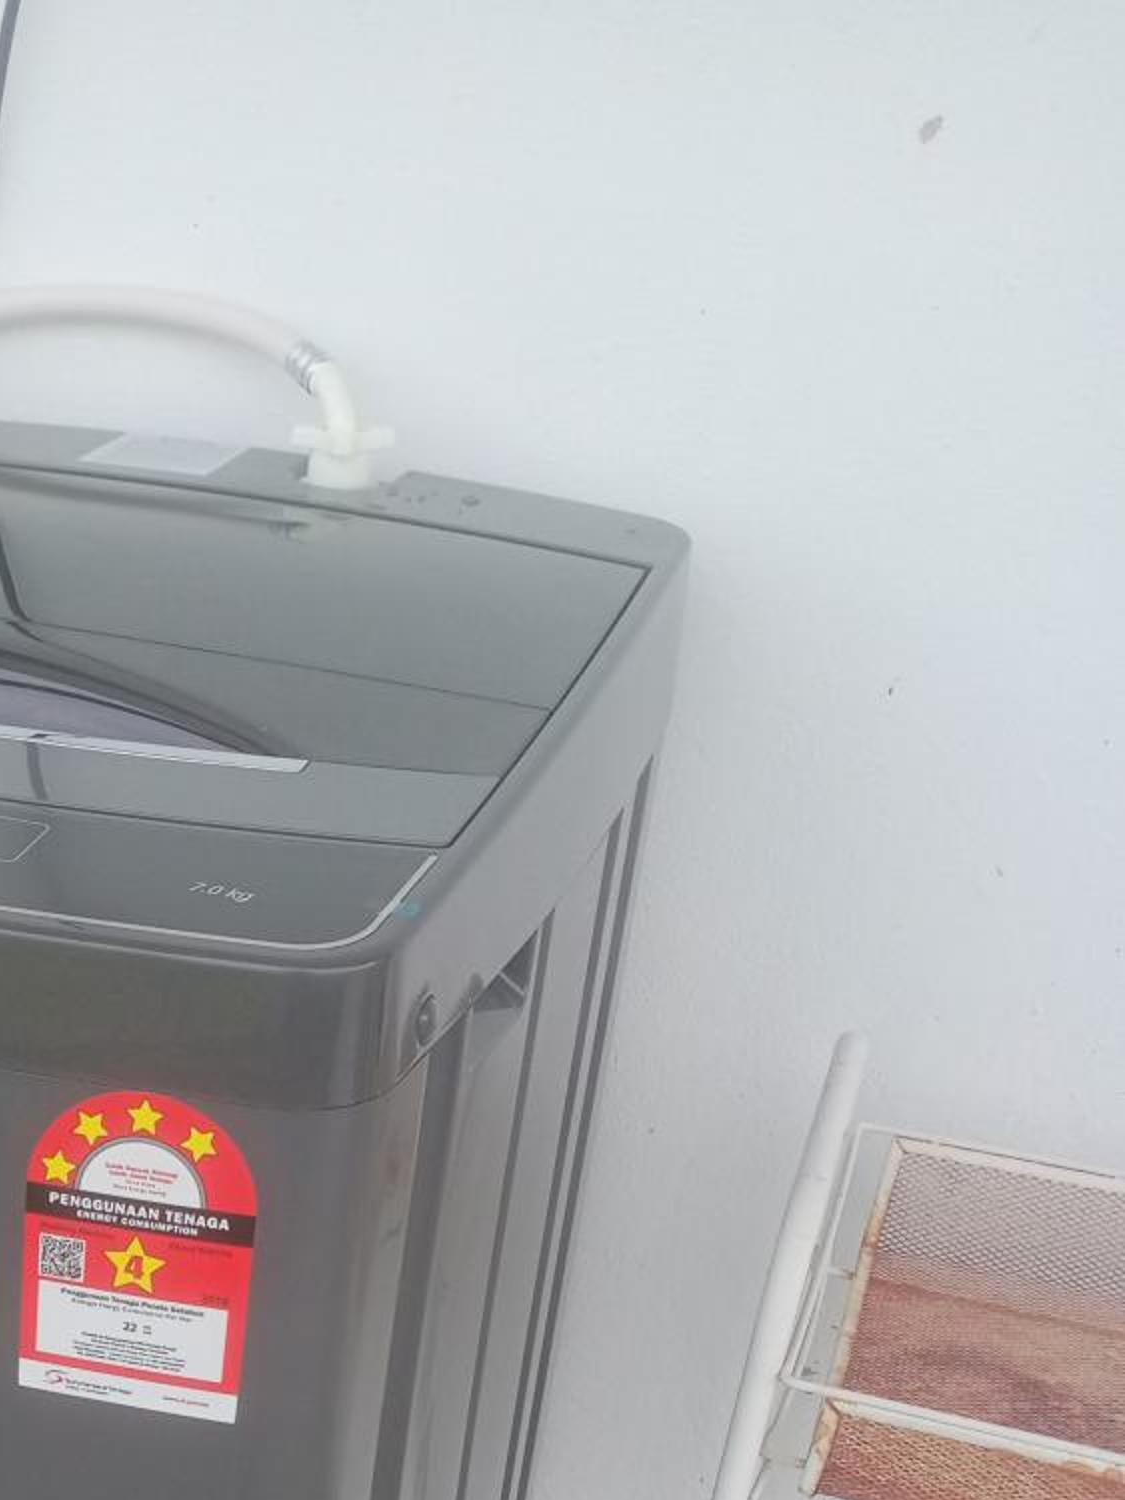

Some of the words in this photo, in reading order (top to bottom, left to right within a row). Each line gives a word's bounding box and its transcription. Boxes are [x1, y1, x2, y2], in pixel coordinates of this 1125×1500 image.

[189, 881, 225, 895] 7.0
[225, 887, 255, 903] kg
[48, 1190, 160, 1221] PENGGUNAAN
[165, 1210, 230, 1232] TENAGA
[77, 1209, 118, 1224] ENERGY
[122, 1215, 198, 1236] CONSUMPTION
[125, 1255, 144, 1280] 4
[123, 1321, 138, 1333] 22
